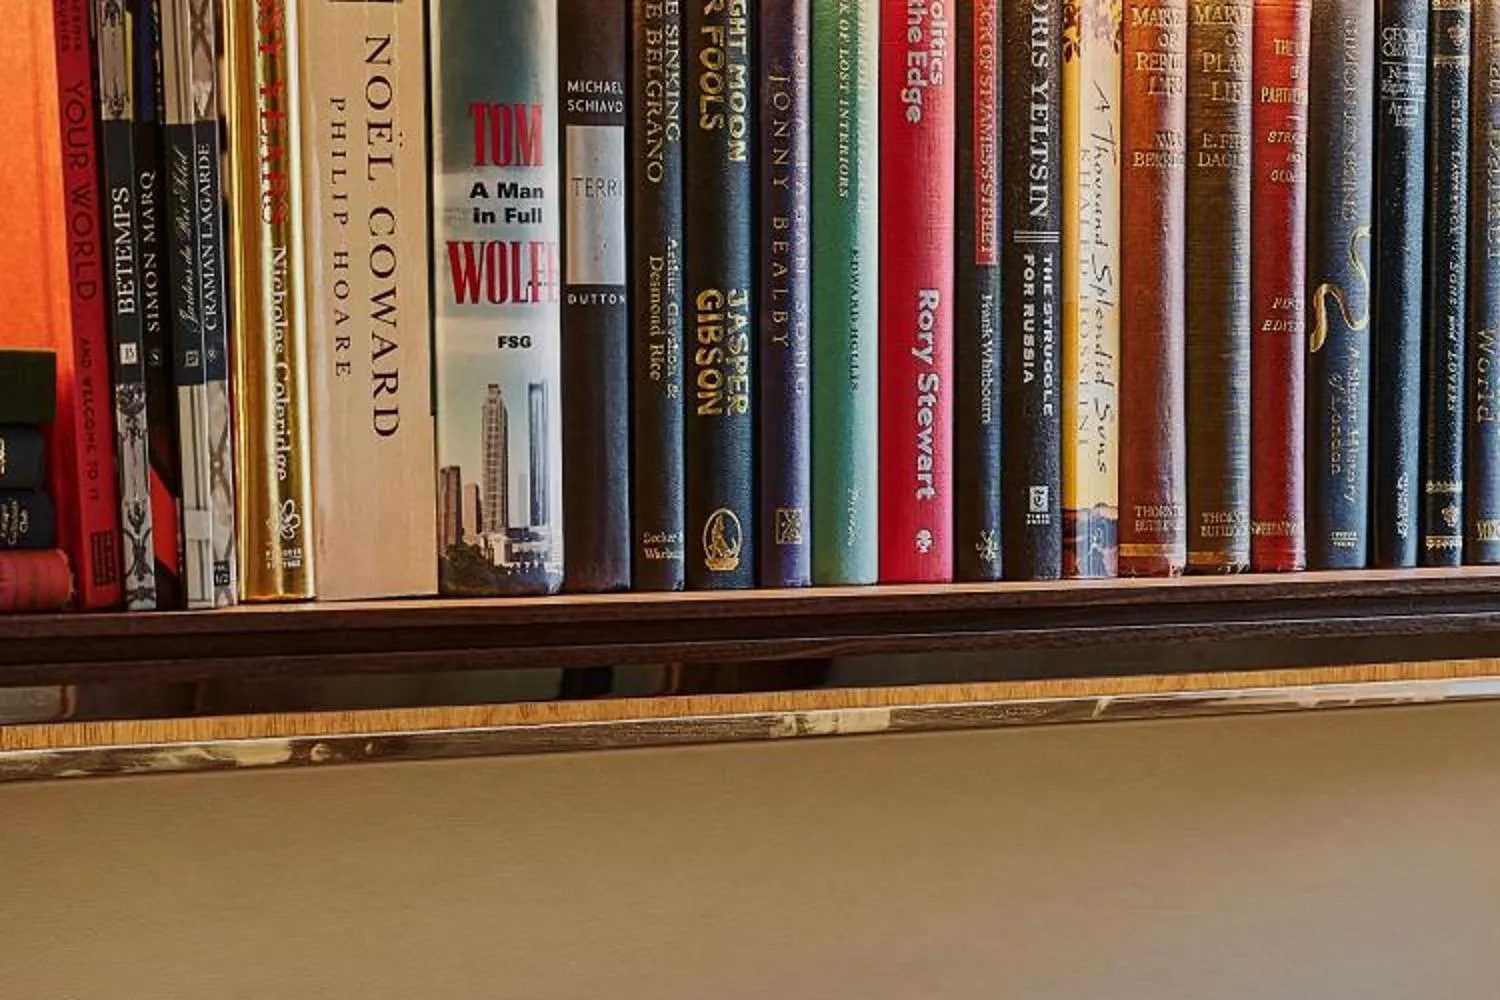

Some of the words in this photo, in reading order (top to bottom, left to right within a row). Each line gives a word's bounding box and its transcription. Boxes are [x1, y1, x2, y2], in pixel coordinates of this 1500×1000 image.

[700, 26, 725, 131] FOOLS
[839, 19, 850, 42] OF
[839, 48, 850, 90] LOST
[929, 0, 948, 86] olitics
[64, 80, 89, 170] YOUR
[365, 33, 403, 181] NOËL
[567, 80, 624, 94] MICHAEL
[567, 99, 624, 113] SCHIAVO
[646, 28, 664, 184] BELGRANO
[665, 24, 681, 142] SINKING
[727, 63, 747, 162] MOON
[901, 51, 928, 124] Edge
[1093, 80, 1112, 113] A
[329, 98, 349, 225] PHILIP
[469, 99, 544, 167] TOM
[769, 74, 791, 190] JONNY
[838, 100, 850, 199] INTERIORS
[1030, 82, 1049, 219] YELTSIN
[1341, 111, 1357, 221] JENKINS
[139, 170, 157, 243] MARQ
[198, 143, 214, 239] LAGARDE
[470, 182, 488, 199] A
[497, 182, 544, 199] Man
[473, 208, 495, 224] in
[505, 208, 543, 224] Full
[1091, 121, 1117, 247] Thousand
[67, 183, 97, 301] WORLD
[112, 186, 135, 315] BETEMPS
[200, 245, 217, 332] CRAMAN
[772, 216, 789, 348] BEALBY
[1024, 254, 1035, 296] FOR
[1043, 253, 1054, 294] THE
[144, 253, 160, 332] SIMON
[271, 246, 288, 353] Nicholas
[333, 251, 351, 377] HOARE
[367, 206, 401, 438] COWARD
[649, 255, 664, 337] Desmond
[911, 288, 941, 365] Rory
[1089, 254, 1114, 387] Splendid
[498, 335, 532, 349] FSG
[649, 344, 665, 381] Rice
[696, 288, 725, 416] GIBSON
[727, 288, 749, 416] JASPER
[1023, 303, 1035, 384] RUSSIA
[1042, 302, 1053, 417] STRUGGLE
[1476, 327, 1497, 424] World
[271, 361, 291, 481] Coleridge
[915, 372, 941, 500] Stewart
[1093, 397, 1112, 473] Suns
[1330, 395, 1344, 475] London
[1343, 428, 1359, 504] History
